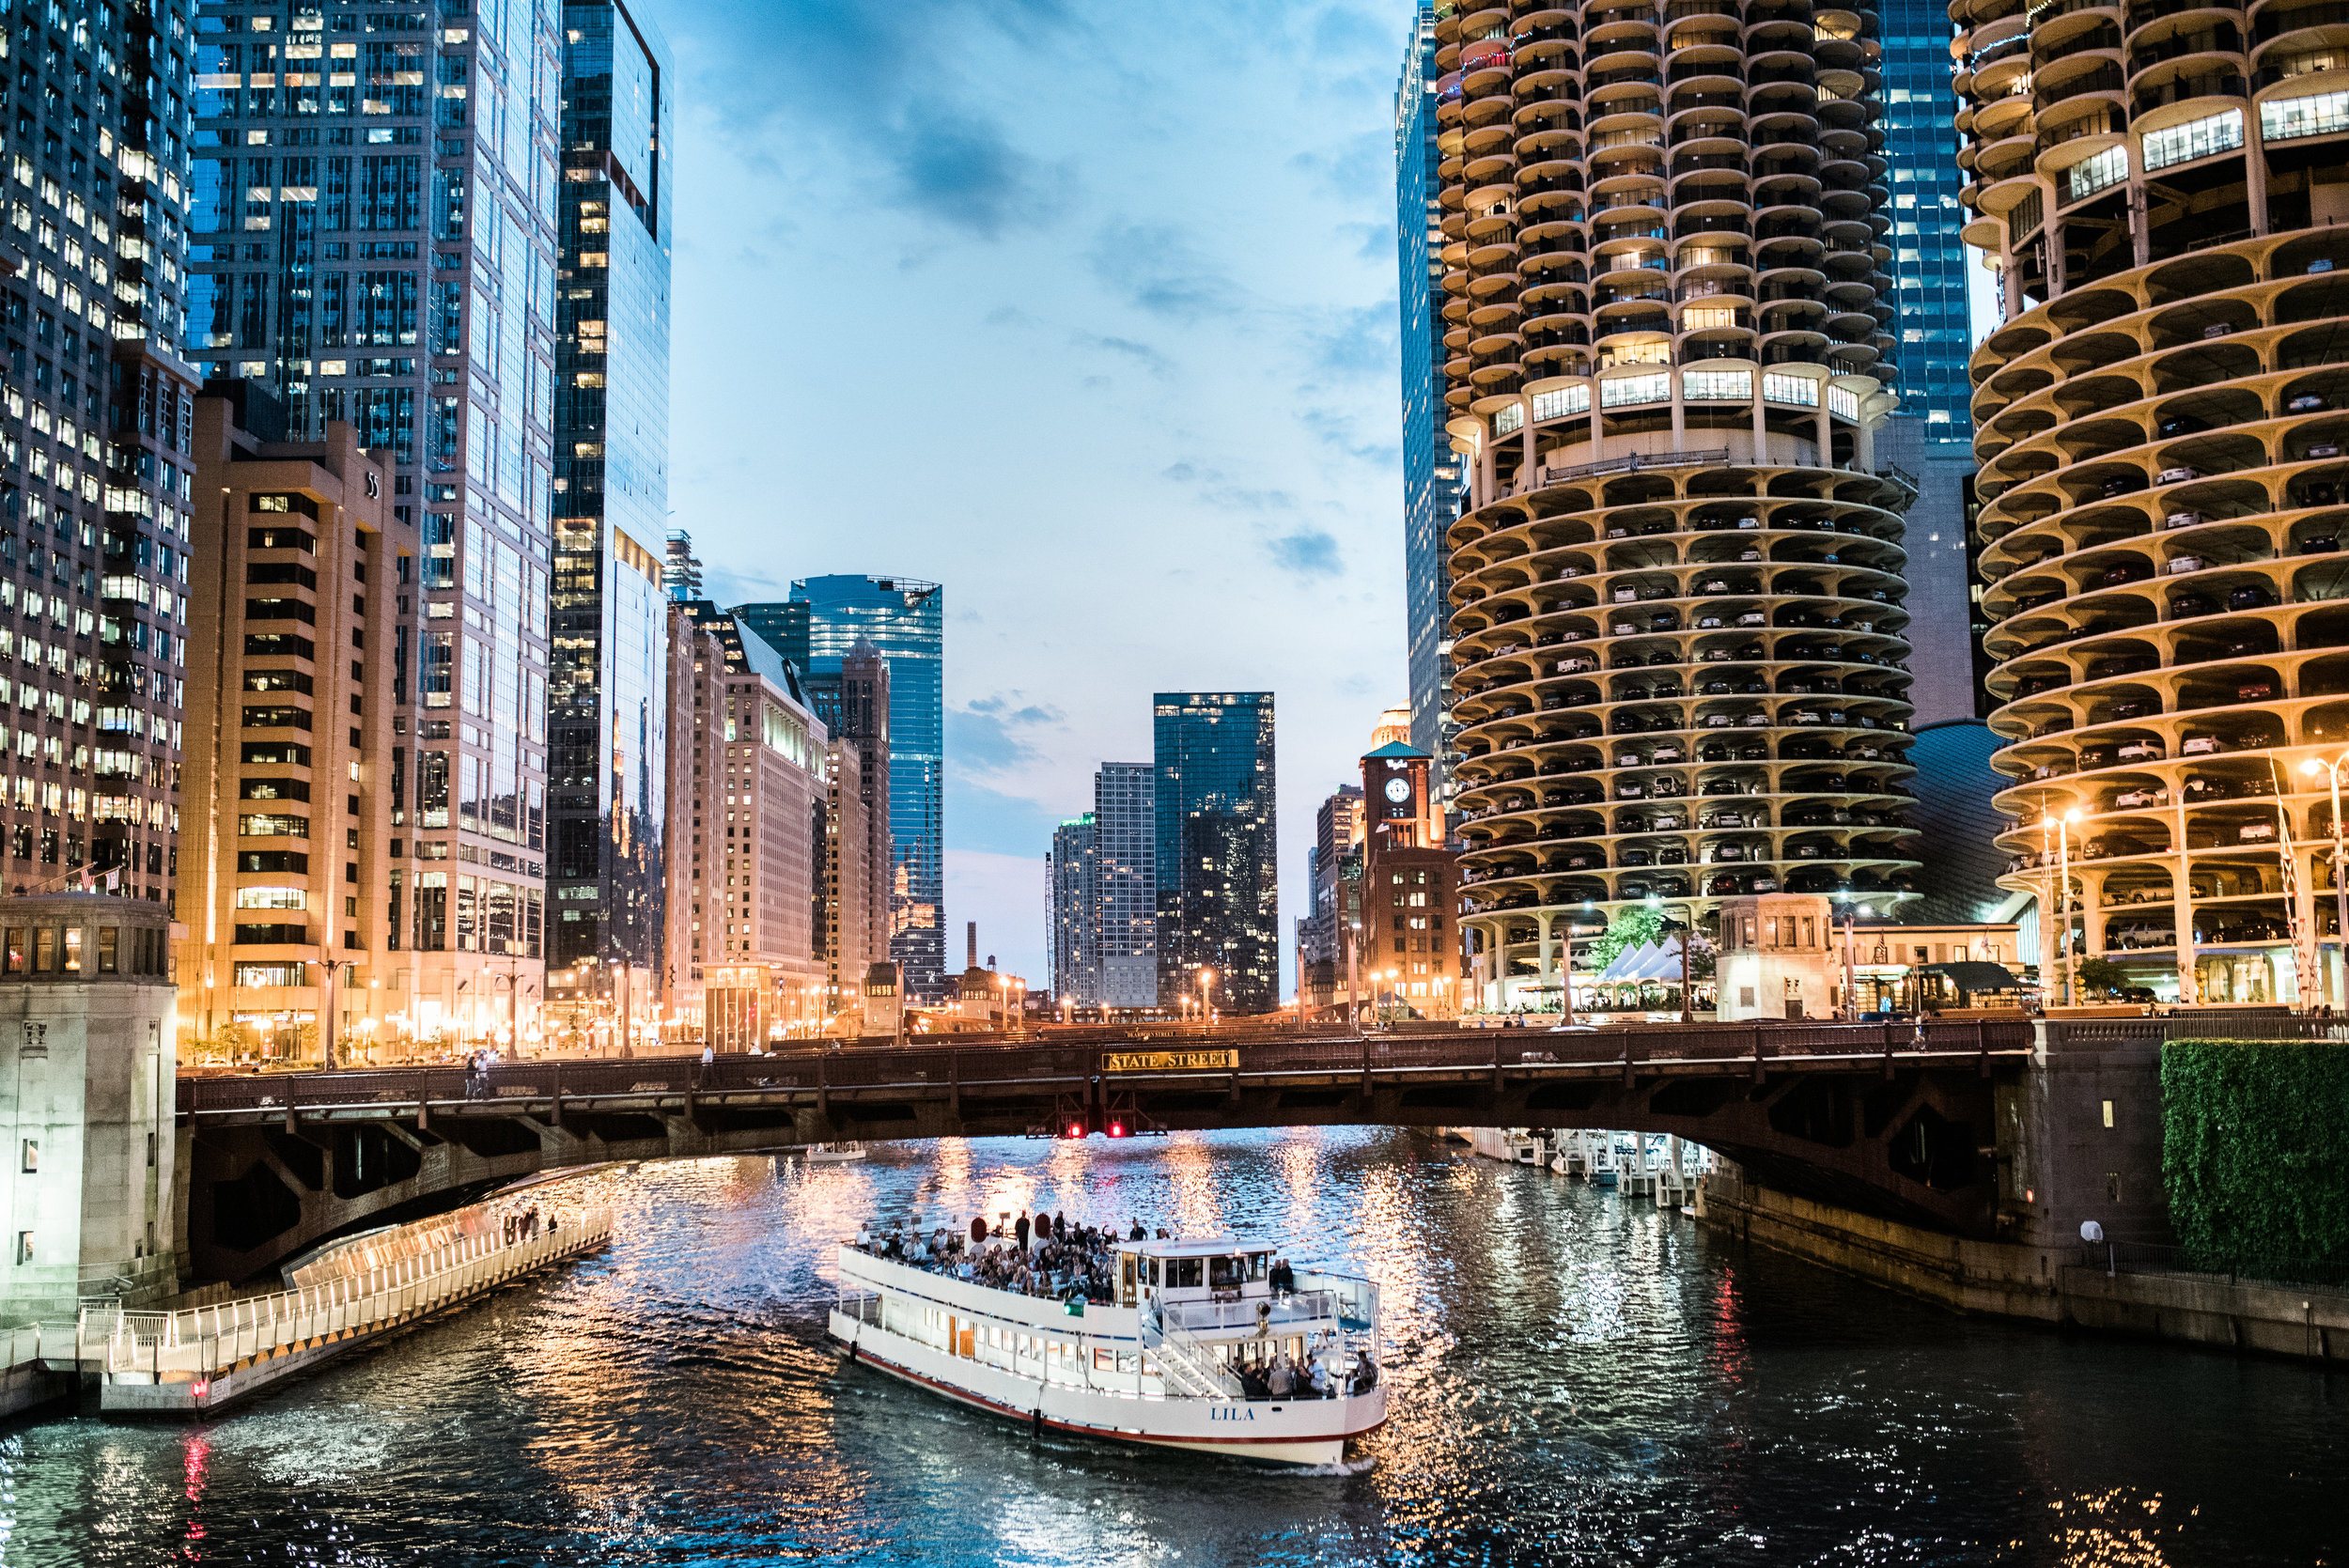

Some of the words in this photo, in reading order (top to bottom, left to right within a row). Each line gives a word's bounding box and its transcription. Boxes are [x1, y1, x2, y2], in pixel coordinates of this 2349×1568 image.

[367, 472, 380, 500] 55
[1111, 1054, 1159, 1068] STATE
[1167, 1052, 1228, 1067] STREET
[1210, 1407, 1255, 1421] LILA
